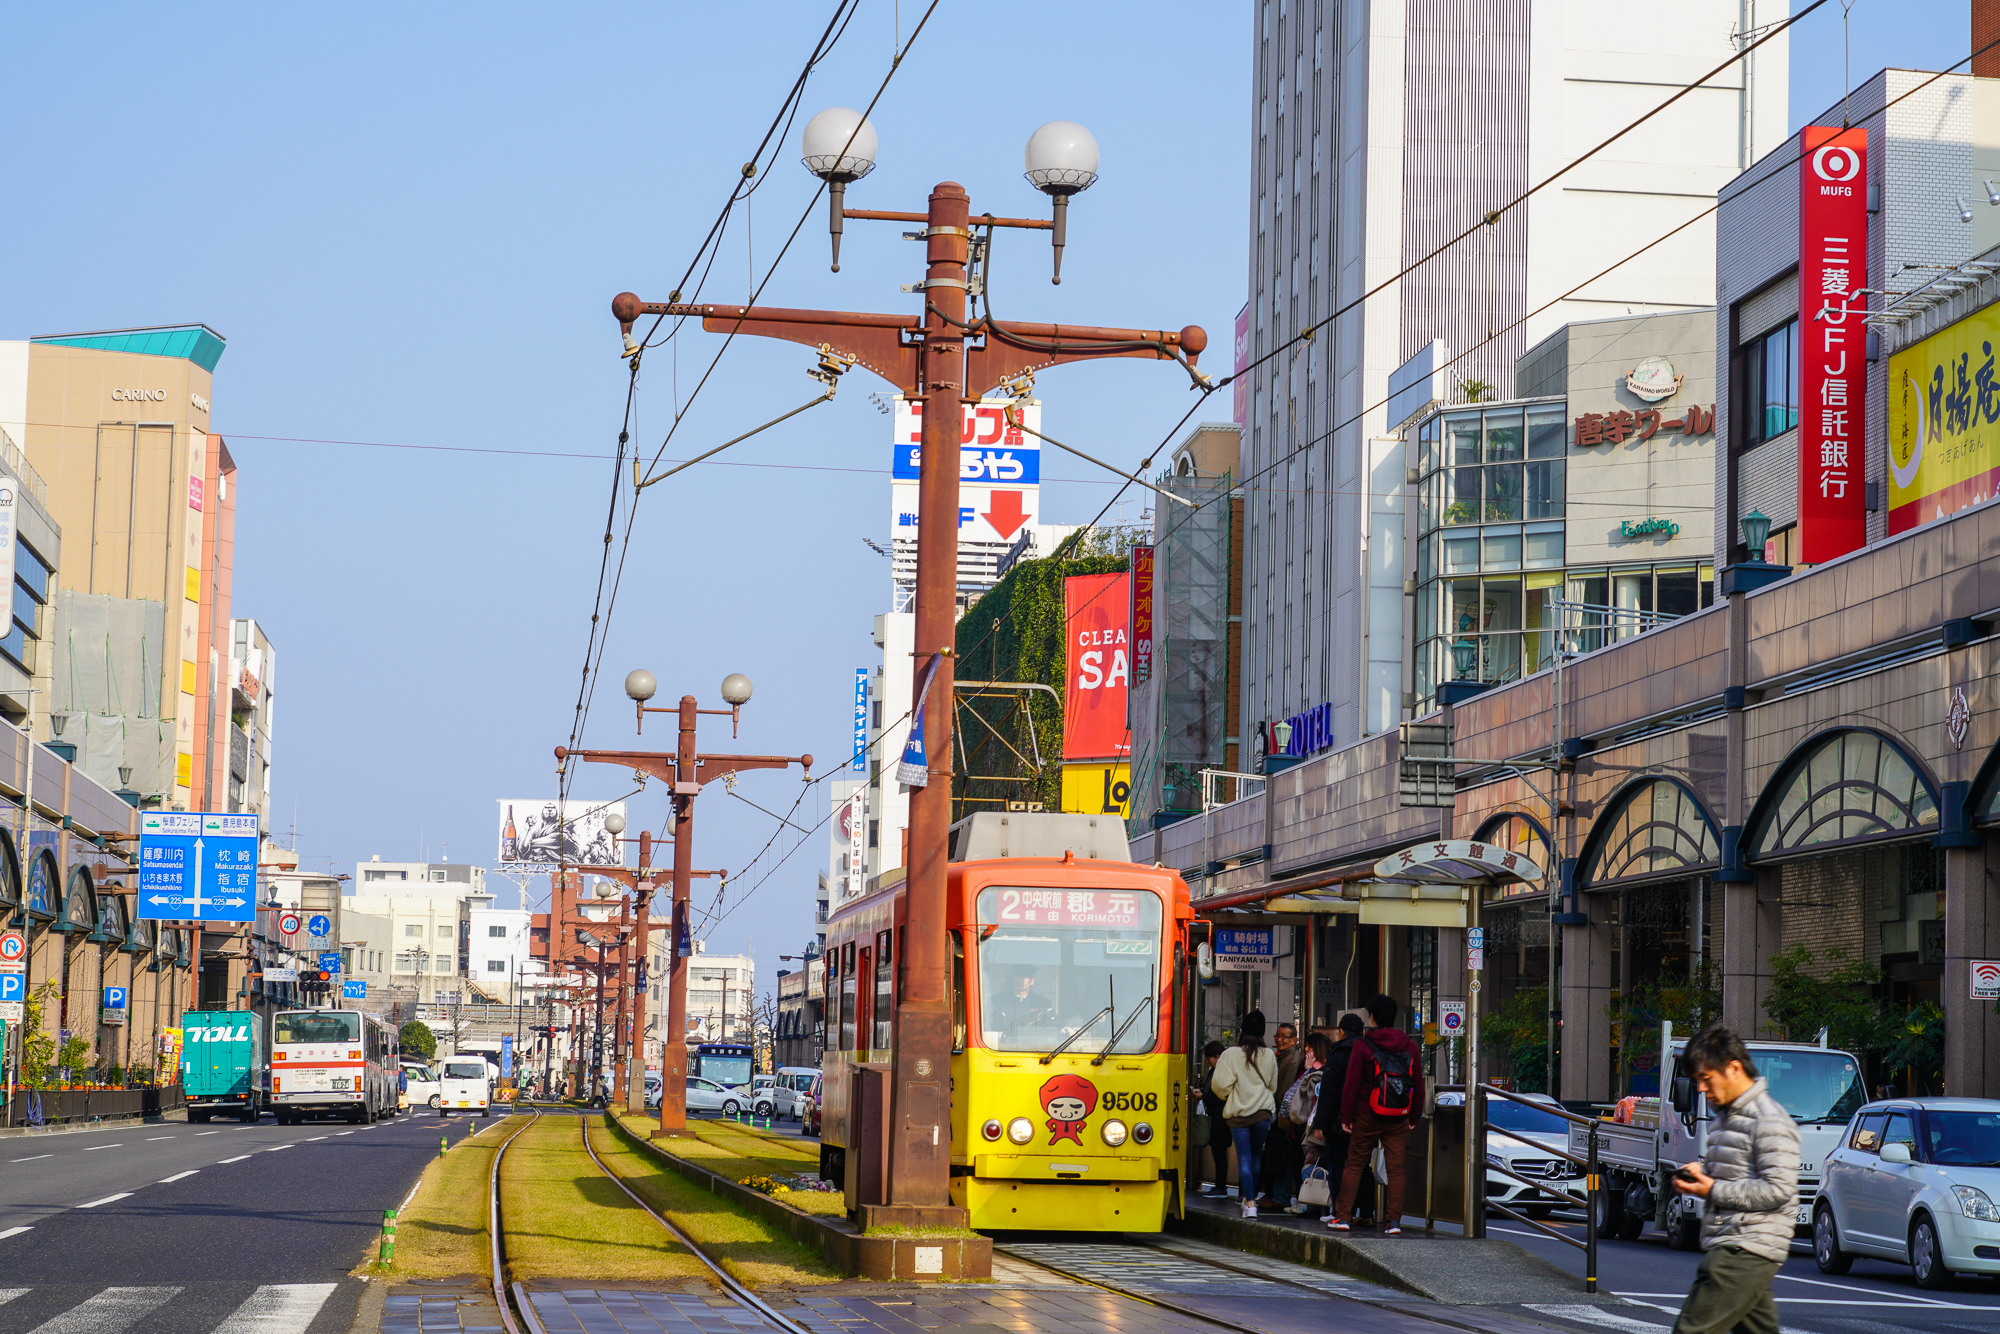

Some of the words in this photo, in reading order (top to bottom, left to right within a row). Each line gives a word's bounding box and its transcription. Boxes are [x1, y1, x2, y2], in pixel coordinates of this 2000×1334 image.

[1820, 185, 1852, 197] MUFG
[1819, 236, 1850, 499] 三菱UFJ信託銀行
[1629, 382, 1655, 393] KARAIMO
[112, 388, 168, 402] CARINO
[1574, 404, 1715, 446] 唐芋ワール
[1136, 556, 1153, 633] カラオケ
[855, 673, 867, 757] アートネイチャー
[163, 816, 200, 827] 桜島フェリー
[223, 818, 256, 828] 鹿児島本港
[143, 847, 184, 861] 薩摩川内
[852, 821, 861, 876] さめしま眼科
[218, 849, 250, 862] 枕崎
[1398, 843, 1518, 870] 天文館通
[143, 861, 184, 869] Satsumasendai
[215, 863, 254, 871] Makurazaki
[142, 873, 183, 884] いちき串木野
[217, 873, 250, 886] 指宿
[1001, 890, 1020, 919] 2
[1022, 891, 1062, 909] 中央駅前
[1025, 910, 1059, 921] 経由
[1071, 913, 1131, 923] KORIMOTO
[284, 920, 296, 929] 40
[1234, 932, 1268, 944] 騎射場
[1109, 941, 1150, 952] ワンマン
[1241, 945, 1257, 953] 谷山
[1259, 945, 1268, 954] 行
[2, 976, 19, 998] P
[110, 989, 122, 1006] P
[186, 1026, 249, 1042] TOLL
[1102, 1091, 1158, 1112] 9508
